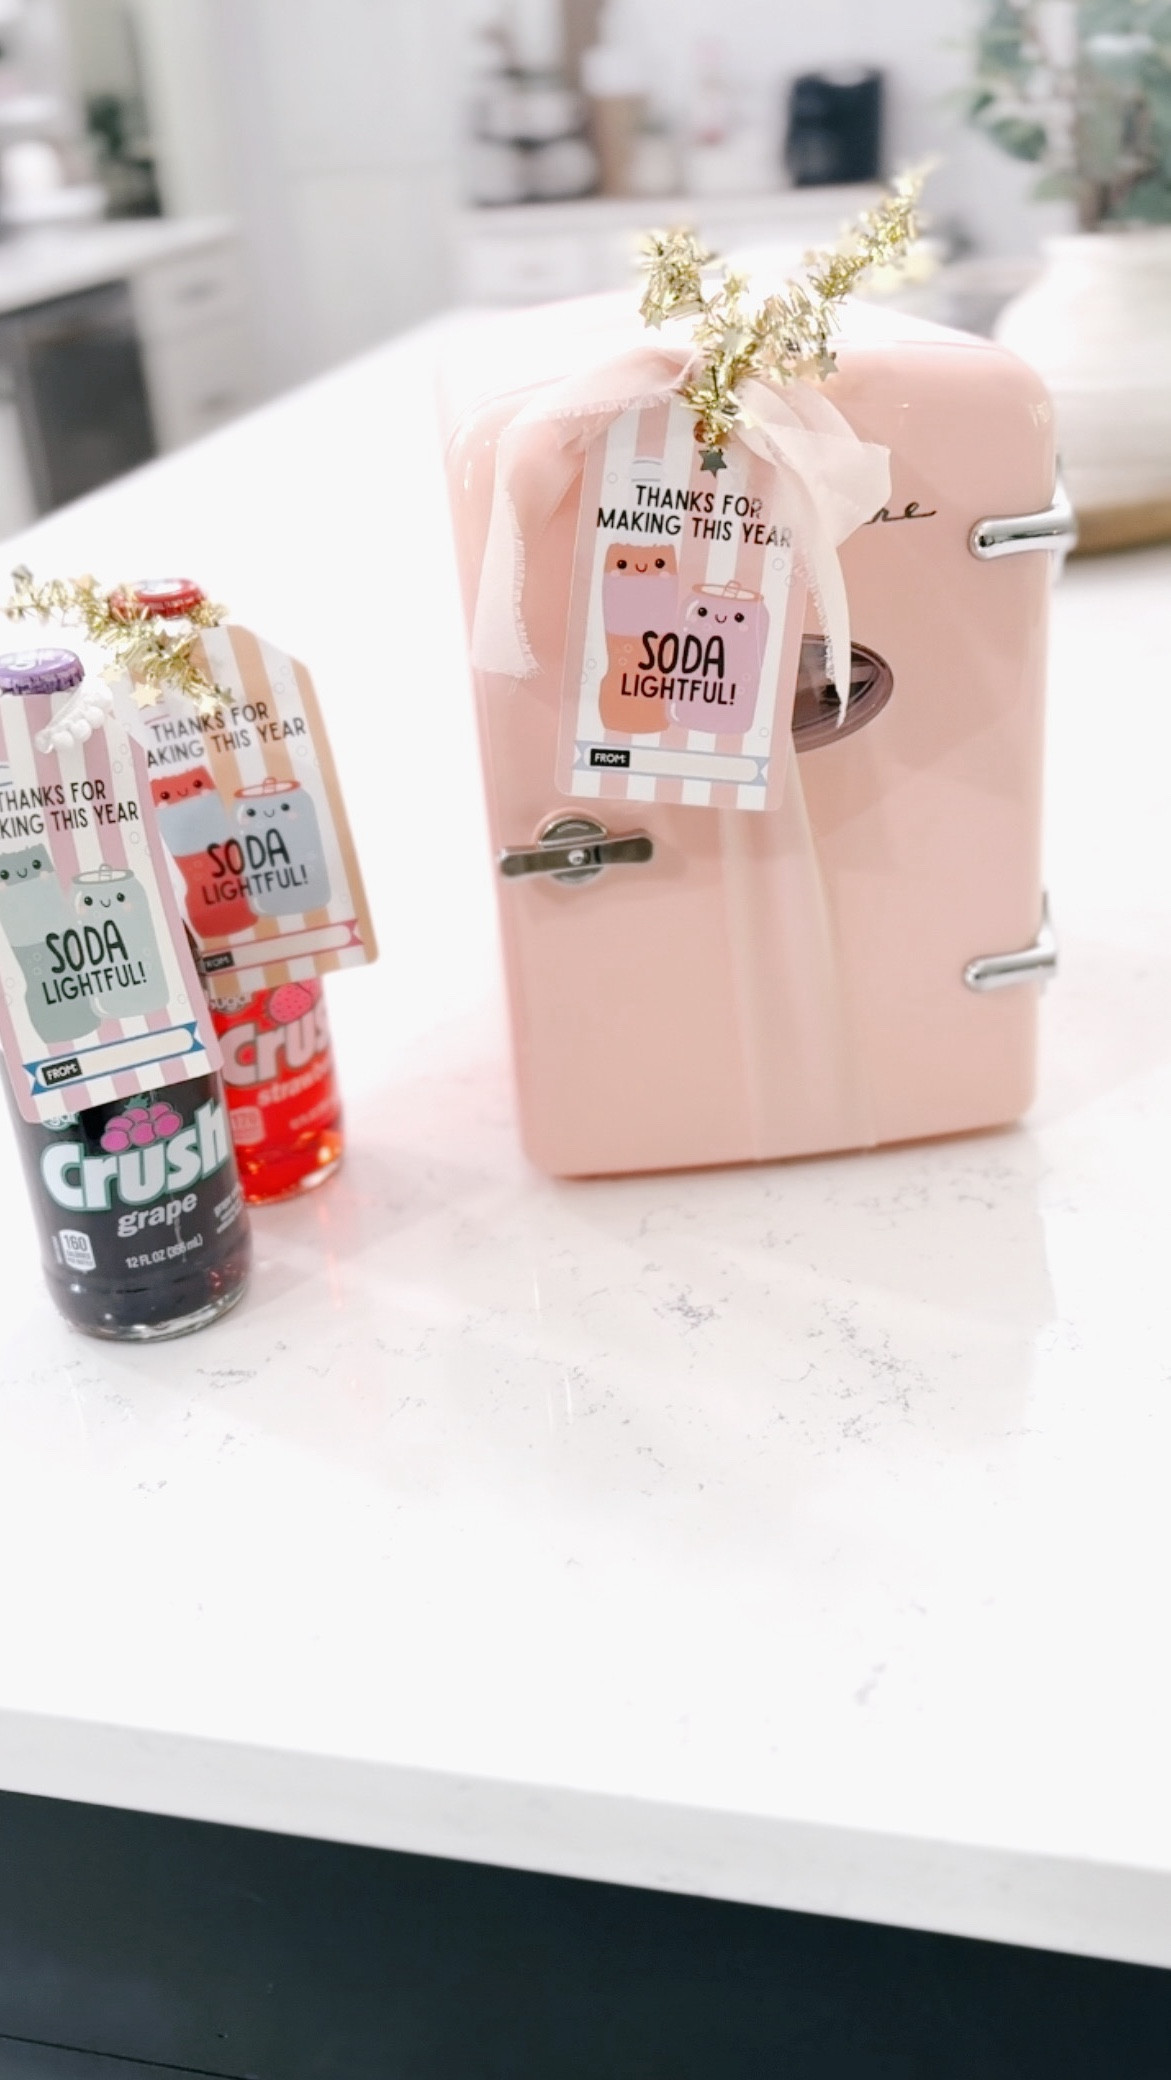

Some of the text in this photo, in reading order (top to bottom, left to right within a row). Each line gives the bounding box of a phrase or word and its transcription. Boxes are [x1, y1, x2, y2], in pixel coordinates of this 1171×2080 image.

[636, 485, 763, 519] THANKS FOR
[597, 507, 793, 548] MAKING THIS YEAR
[637, 630, 725, 679] SODA
[621, 672, 737, 706] LIGHTFUL!
[147, 716, 306, 768] AKING THIS YEAR
[151, 701, 270, 743] THANKS FOR
[70, 779, 106, 803] FOR
[0, 800, 139, 839] KING THIS YEAR
[206, 828, 291, 879] SODA
[202, 864, 309, 906] LIGHTFUL!
[45, 919, 129, 974] SODA
[42, 961, 147, 1006] LIGHTFUL!
[40, 1097, 229, 1213] Crush
[117, 1192, 198, 1238] grape
[125, 1256, 139, 1269] 12
